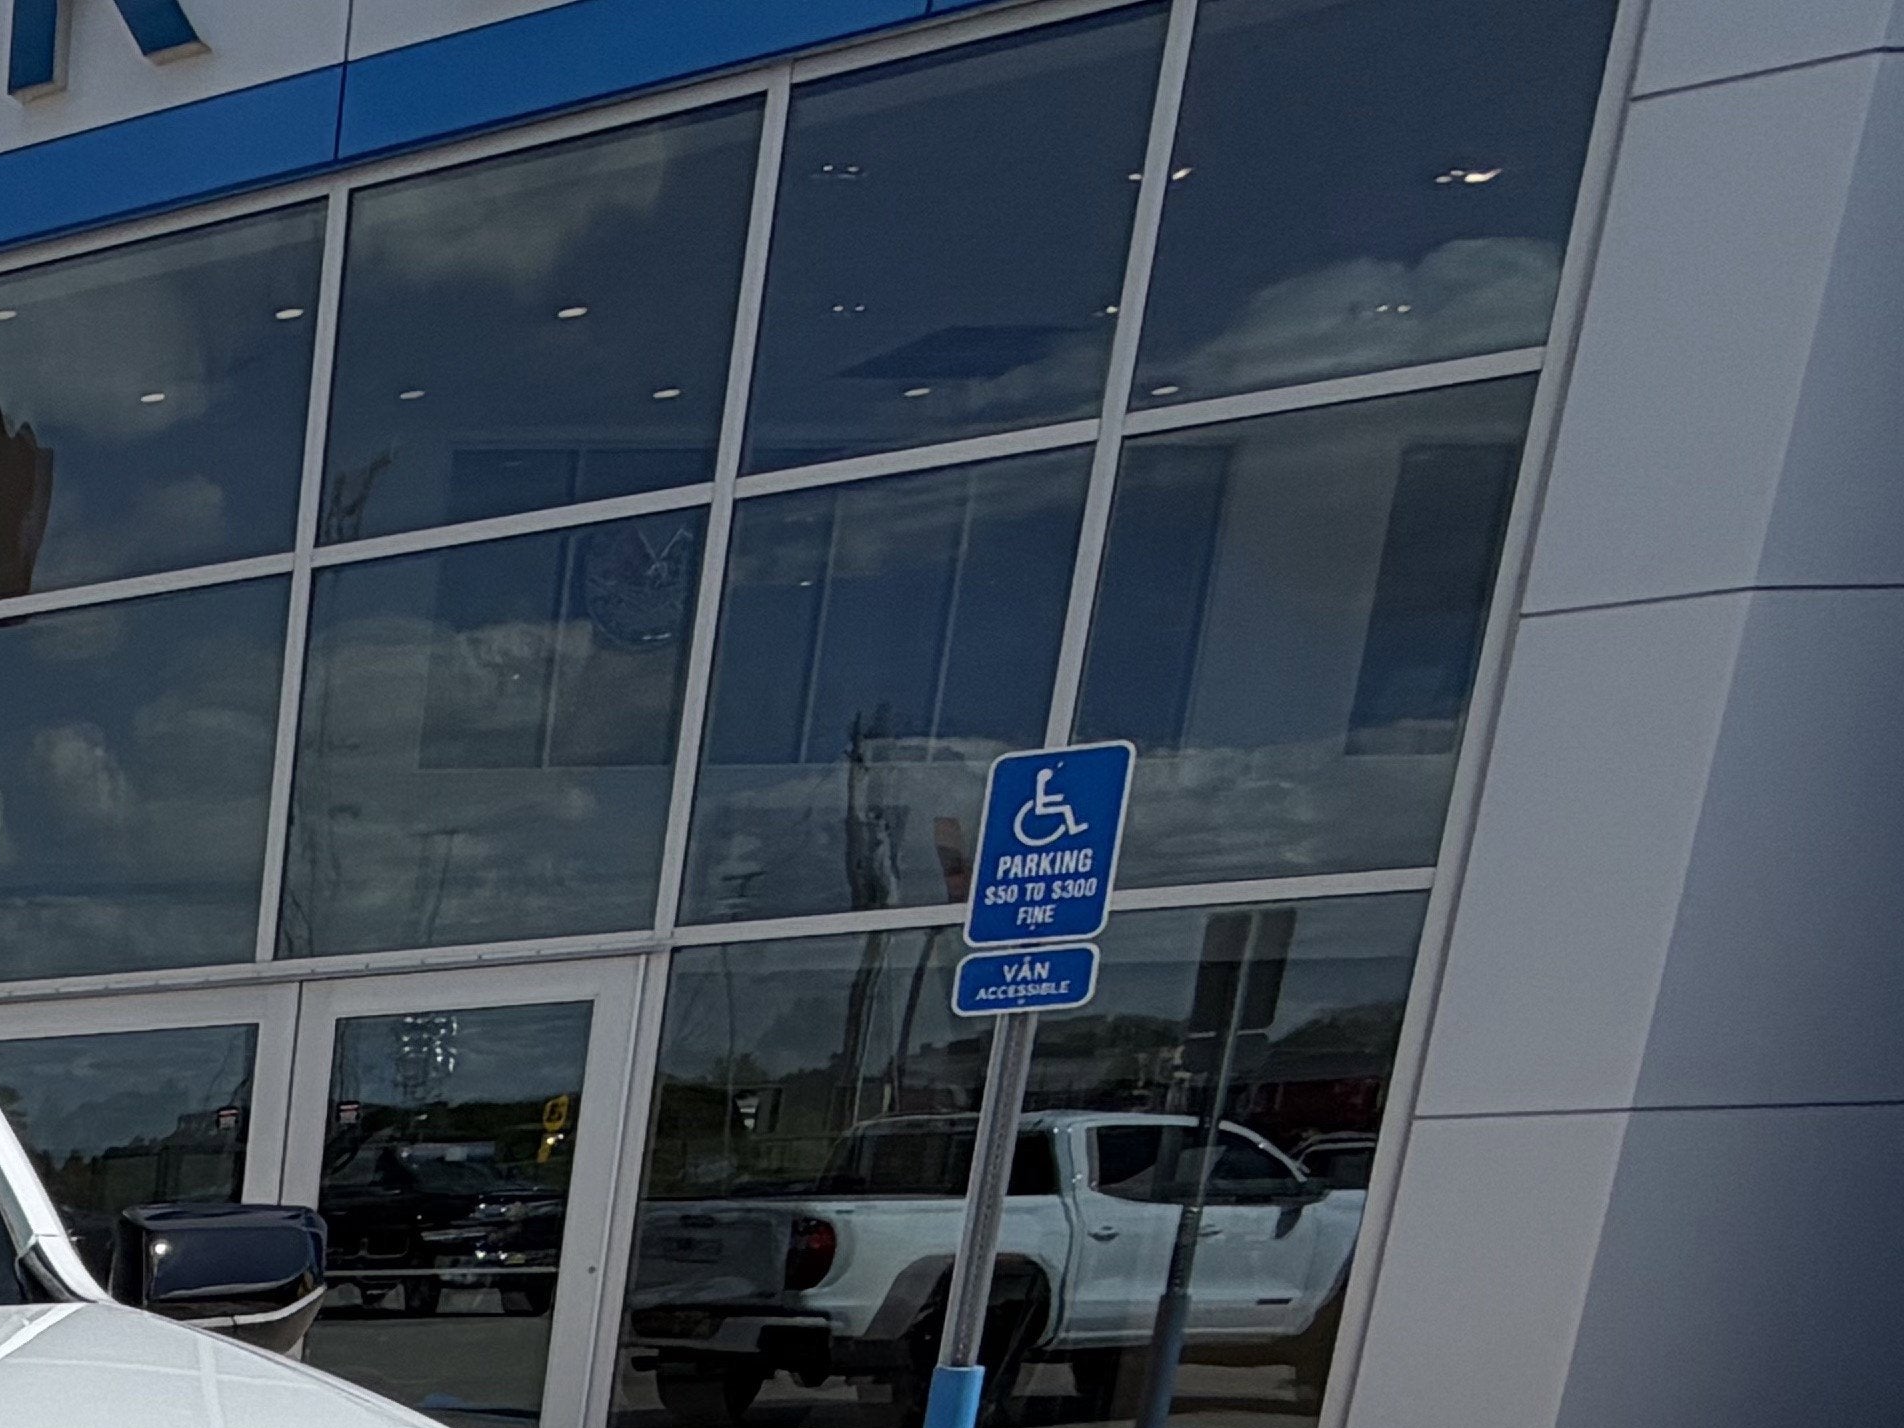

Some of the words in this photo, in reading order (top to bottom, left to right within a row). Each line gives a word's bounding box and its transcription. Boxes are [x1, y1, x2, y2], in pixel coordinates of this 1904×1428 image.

[997, 848, 1094, 880] PARKING
[983, 884, 1019, 906] $50
[1024, 882, 1046, 901] TO
[1051, 877, 1098, 899] $300
[1016, 904, 1056, 925] FINE
[1003, 961, 1050, 983] VAN
[976, 981, 1071, 1001] ACCESSIBLE
